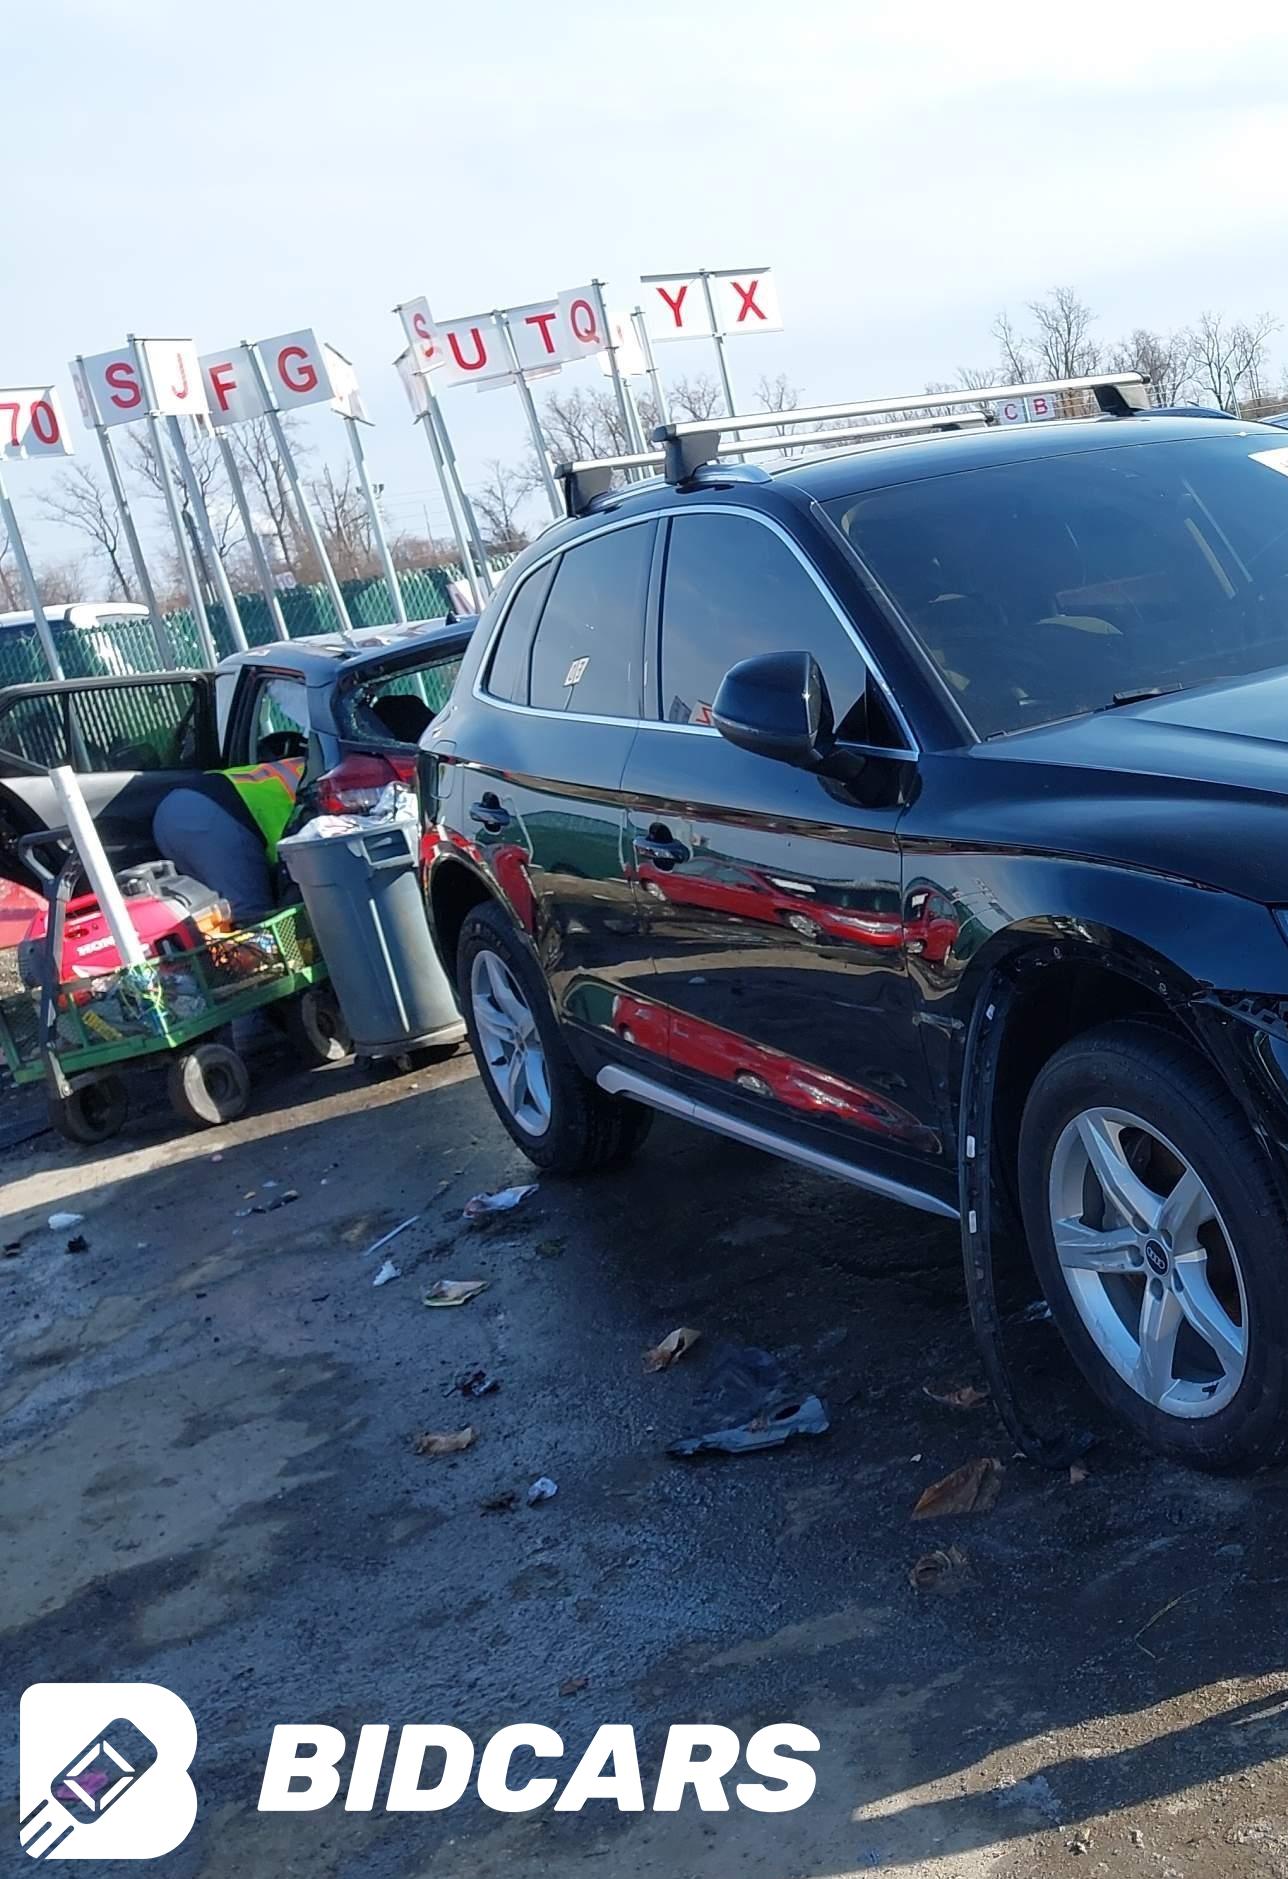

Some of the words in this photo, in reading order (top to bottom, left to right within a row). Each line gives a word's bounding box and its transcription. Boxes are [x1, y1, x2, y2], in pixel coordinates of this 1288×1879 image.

[570, 299, 599, 343] Q
[656, 285, 687, 327] Y
[731, 280, 767, 322] X
[447, 328, 487, 370] U
[526, 313, 556, 353] T
[105, 362, 142, 408] S
[171, 353, 188, 399] J
[208, 362, 237, 411] F
[277, 346, 318, 393] G
[0, 400, 60, 446] 70
[1004, 404, 1018, 420] C
[1033, 398, 1048, 415] B
